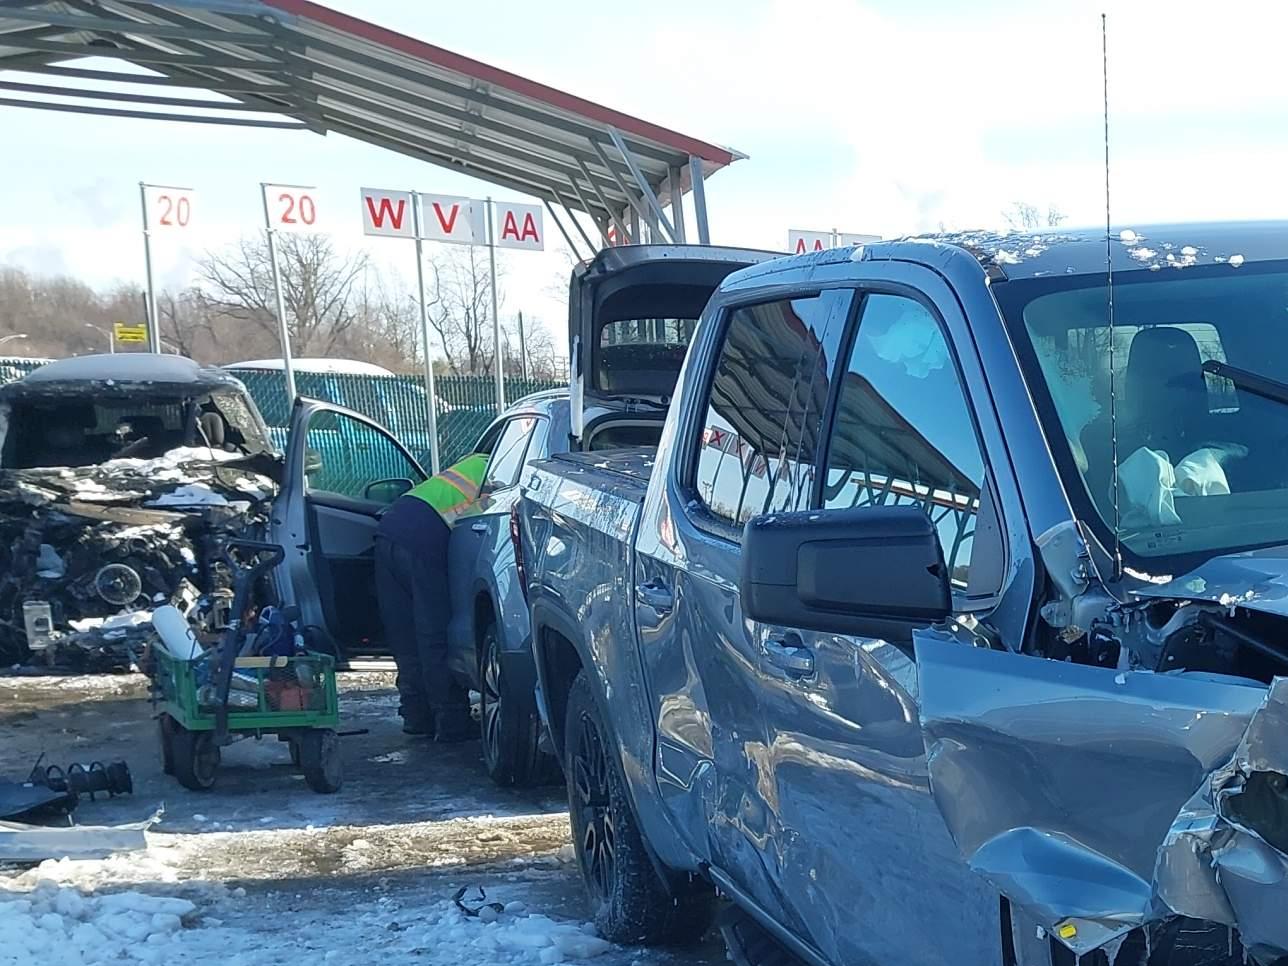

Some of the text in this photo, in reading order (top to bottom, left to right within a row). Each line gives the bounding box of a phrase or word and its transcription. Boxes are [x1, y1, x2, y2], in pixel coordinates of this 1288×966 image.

[158, 195, 190, 227] 20
[279, 193, 316, 226] 20
[365, 196, 405, 230] W
[432, 202, 460, 234] V
[502, 210, 540, 243] AA
